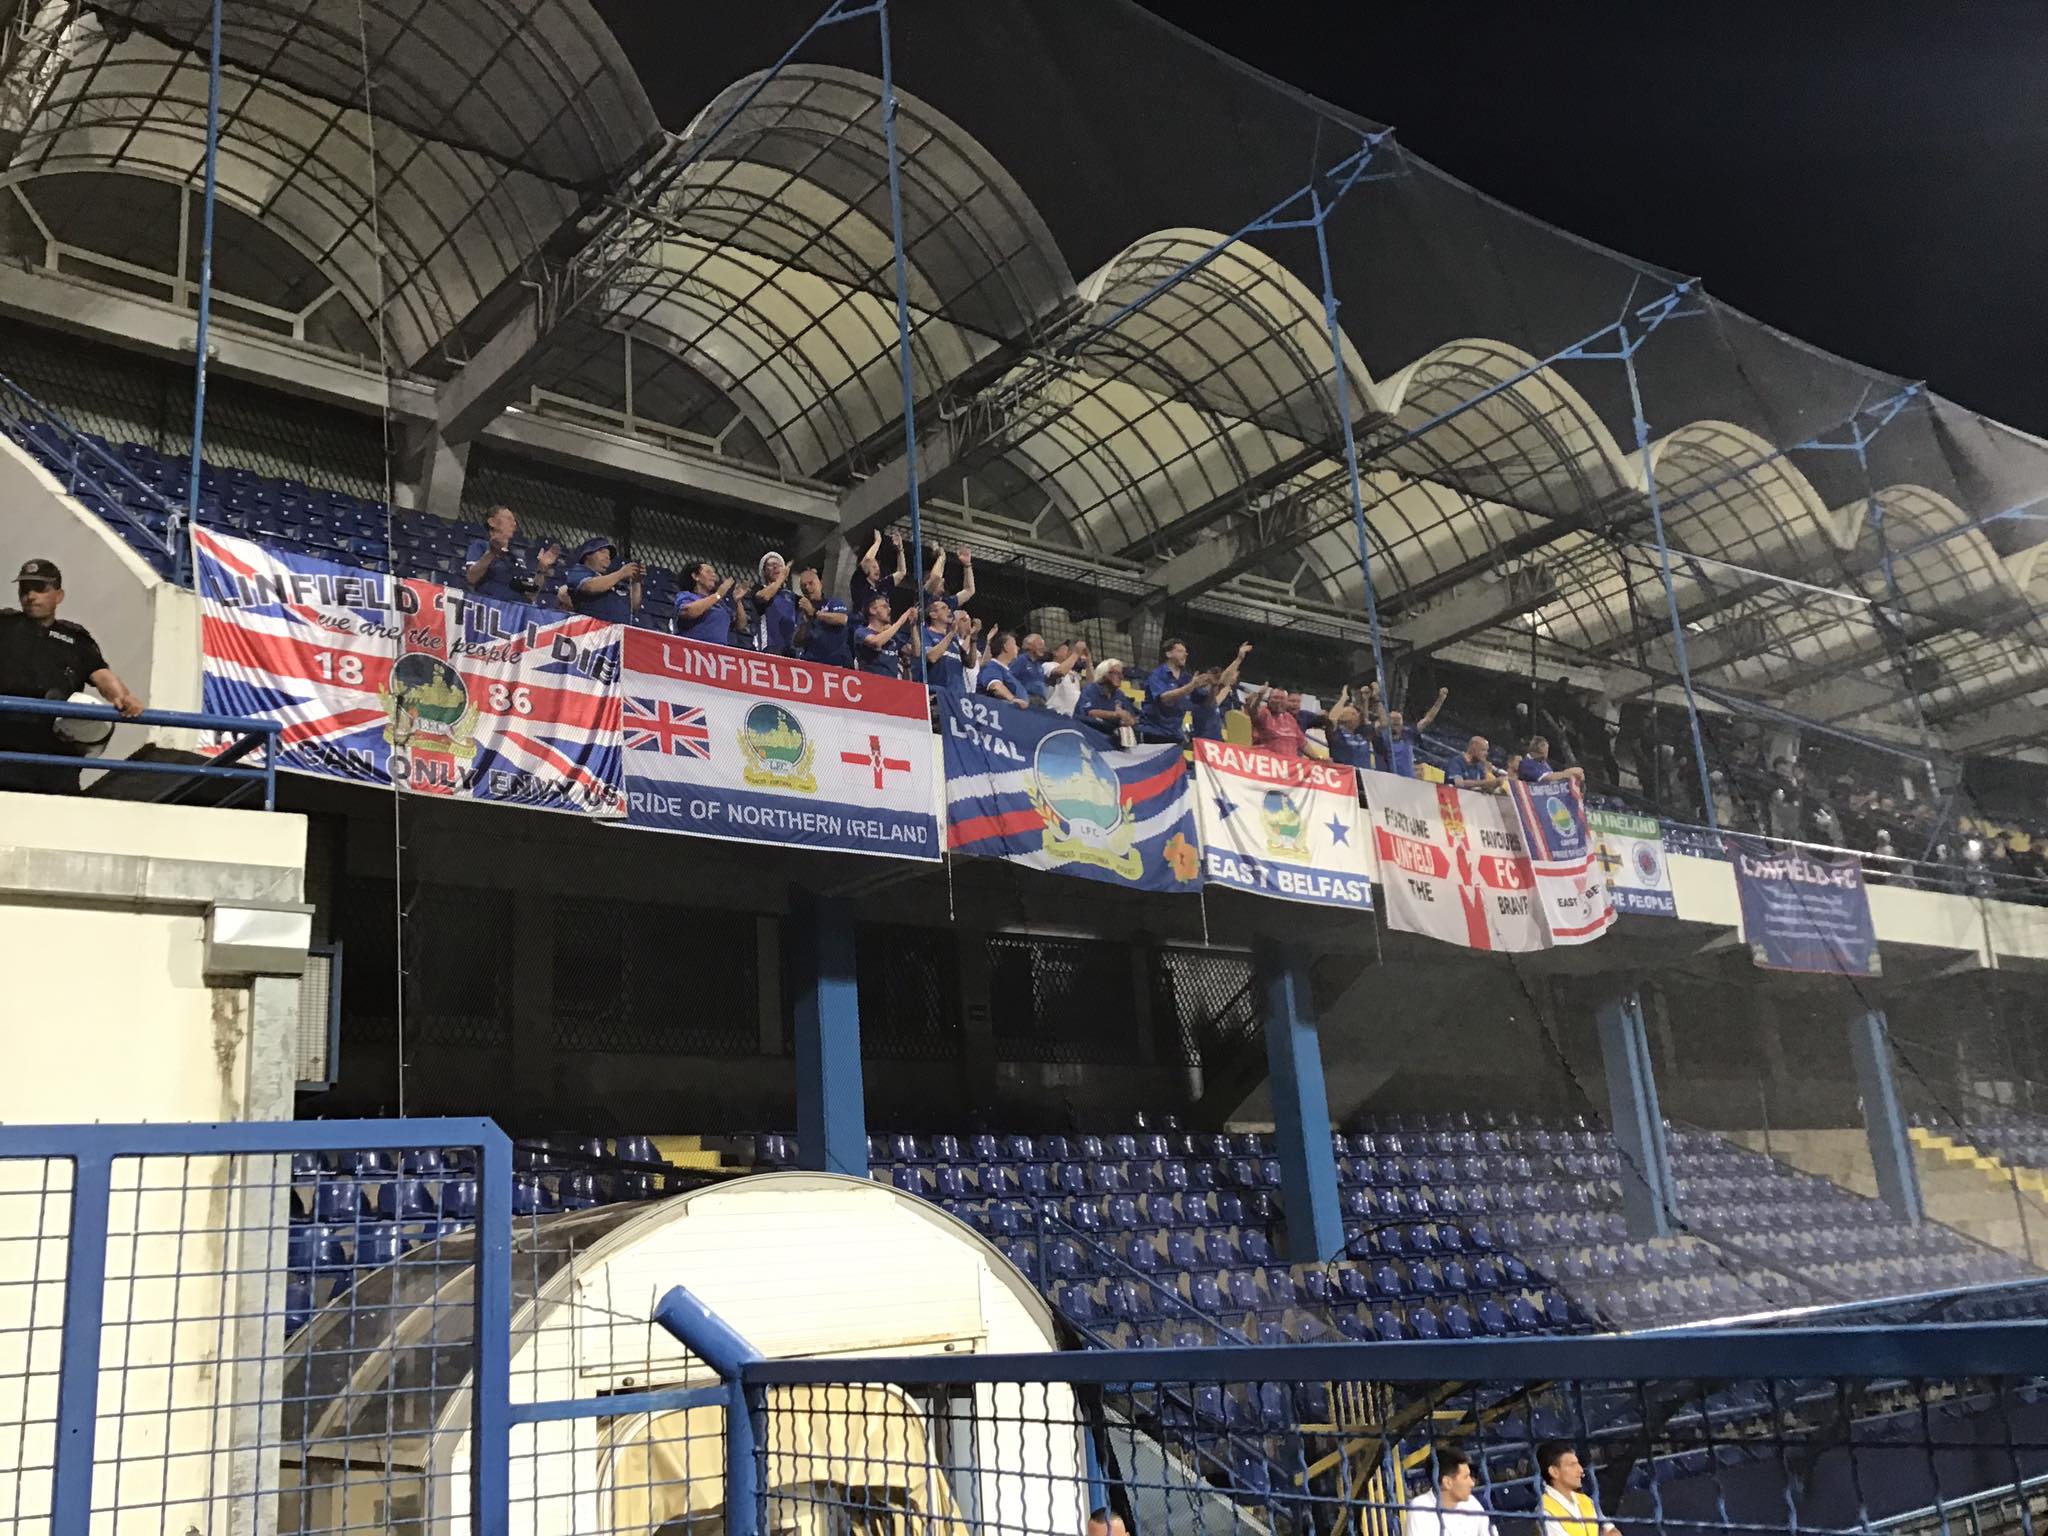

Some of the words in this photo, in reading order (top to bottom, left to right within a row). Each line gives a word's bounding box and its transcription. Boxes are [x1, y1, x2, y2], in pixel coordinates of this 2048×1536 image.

[213, 574, 421, 616] LINFIELD
[525, 620, 540, 650] I
[551, 632, 619, 687] DIE
[318, 614, 350, 631] we
[359, 620, 403, 641] are
[408, 625, 443, 650] the
[450, 636, 522, 667] people
[313, 651, 365, 685] 18
[487, 683, 533, 716] 86
[661, 643, 813, 695] LINFIELD
[822, 671, 863, 703] FC
[949, 715, 1027, 763] LOYAL
[1203, 741, 1290, 780] RAVEN
[386, 755, 479, 791] ONLY
[489, 767, 575, 804] ENVY
[582, 783, 621, 808] US
[629, 791, 683, 817] RIDE
[689, 799, 721, 821] OF
[727, 803, 842, 837] NORTHERN
[846, 818, 928, 845] IRELAND
[1606, 814, 1657, 834] IRELAND
[1206, 852, 1271, 889] EAST
[1276, 869, 1373, 904] BELFAST
[1389, 834, 1436, 875] LINFIELD
[1493, 858, 1521, 889] FC
[1407, 878, 1435, 902] THE
[1557, 897, 1579, 908] EAST
[1628, 893, 1674, 911] PEOPLE
